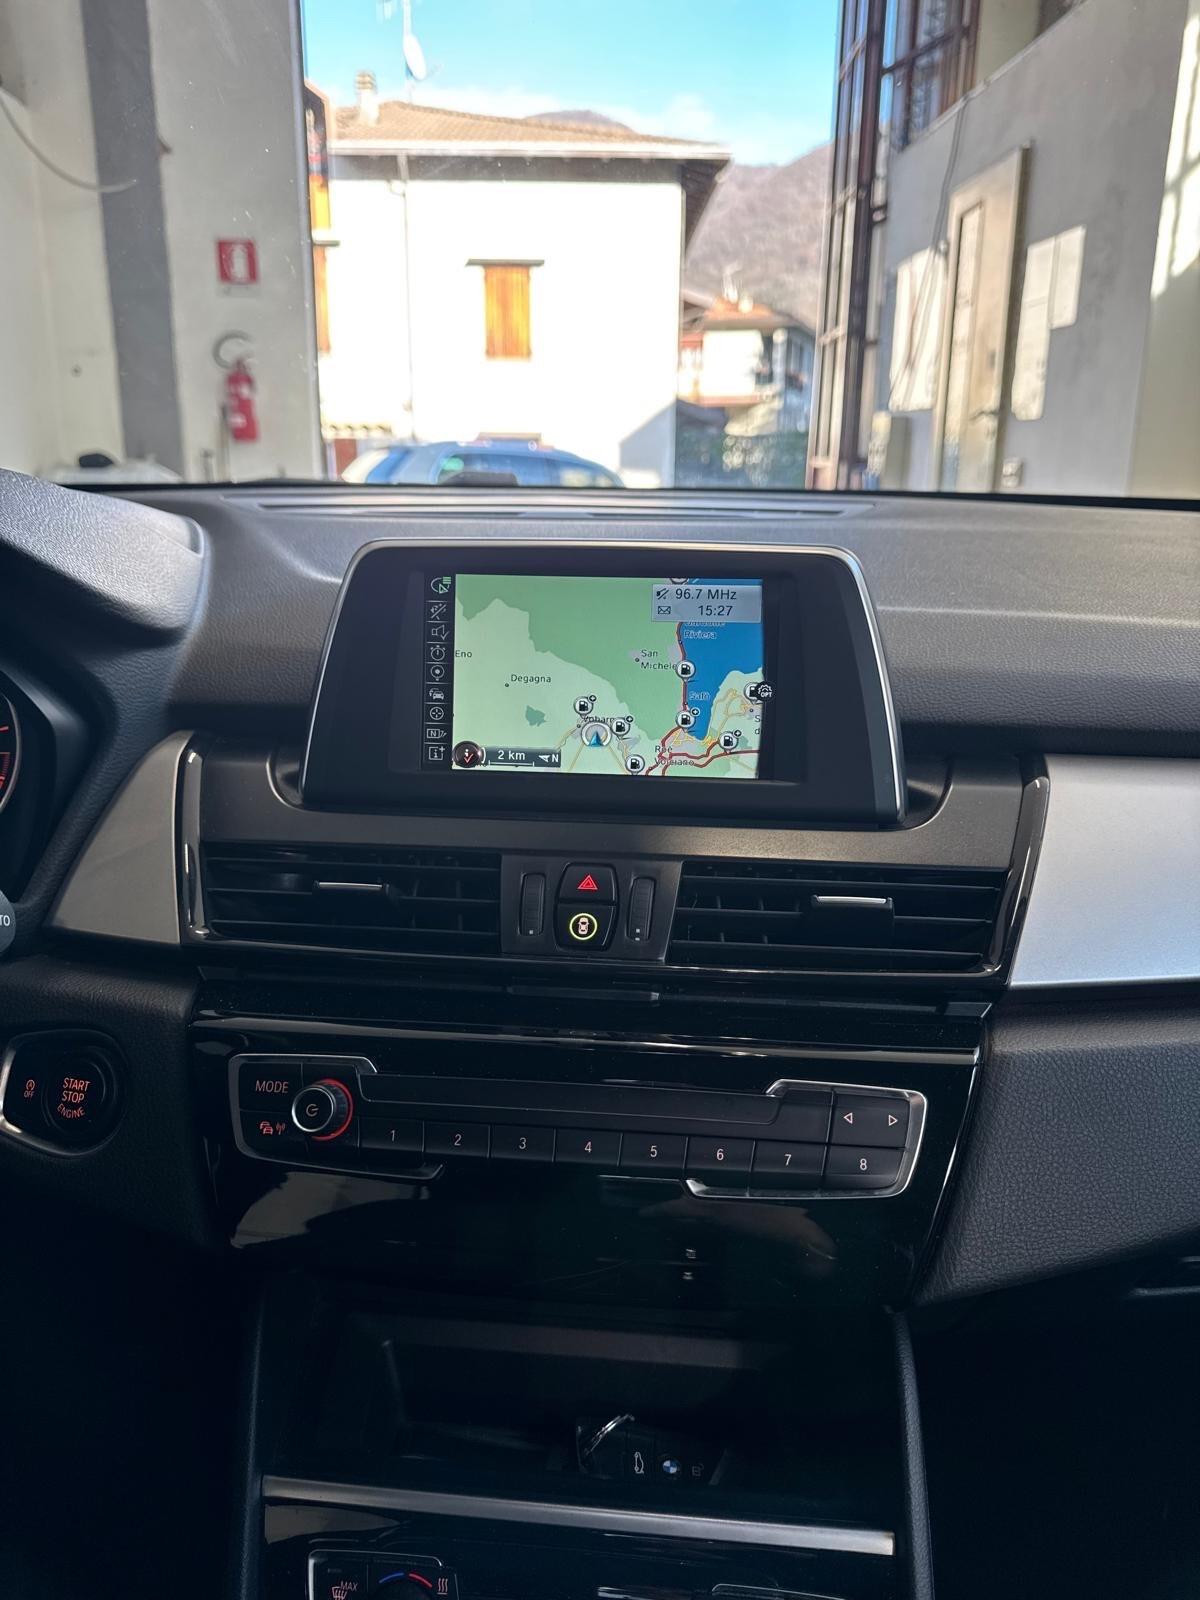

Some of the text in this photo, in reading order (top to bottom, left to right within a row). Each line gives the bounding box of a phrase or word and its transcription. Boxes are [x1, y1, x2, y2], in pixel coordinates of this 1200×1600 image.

[675, 588, 737, 600] 96.7 MHz
[698, 605, 733, 616] 15:27
[455, 650, 472, 658] Eno
[641, 649, 658, 658] San
[641, 661, 677, 671] Michele
[510, 674, 551, 684] Degagna
[498, 751, 525, 760] 2 km
[551, 754, 559, 763] N
[63, 1077, 90, 1091] START
[255, 1080, 289, 1094] MODE
[24, 1090, 35, 1098] OFF
[62, 1090, 84, 1103] STOP
[57, 1103, 86, 1119] ENGINE
[390, 1130, 396, 1142] 1
[454, 1134, 462, 1146] 2
[519, 1137, 527, 1150] 3
[584, 1141, 592, 1153] 4
[650, 1145, 658, 1158] 5
[716, 1149, 724, 1161] 6
[784, 1154, 792, 1166] 7
[859, 1158, 867, 1171] 8
[340, 1581, 358, 1591] MAX
